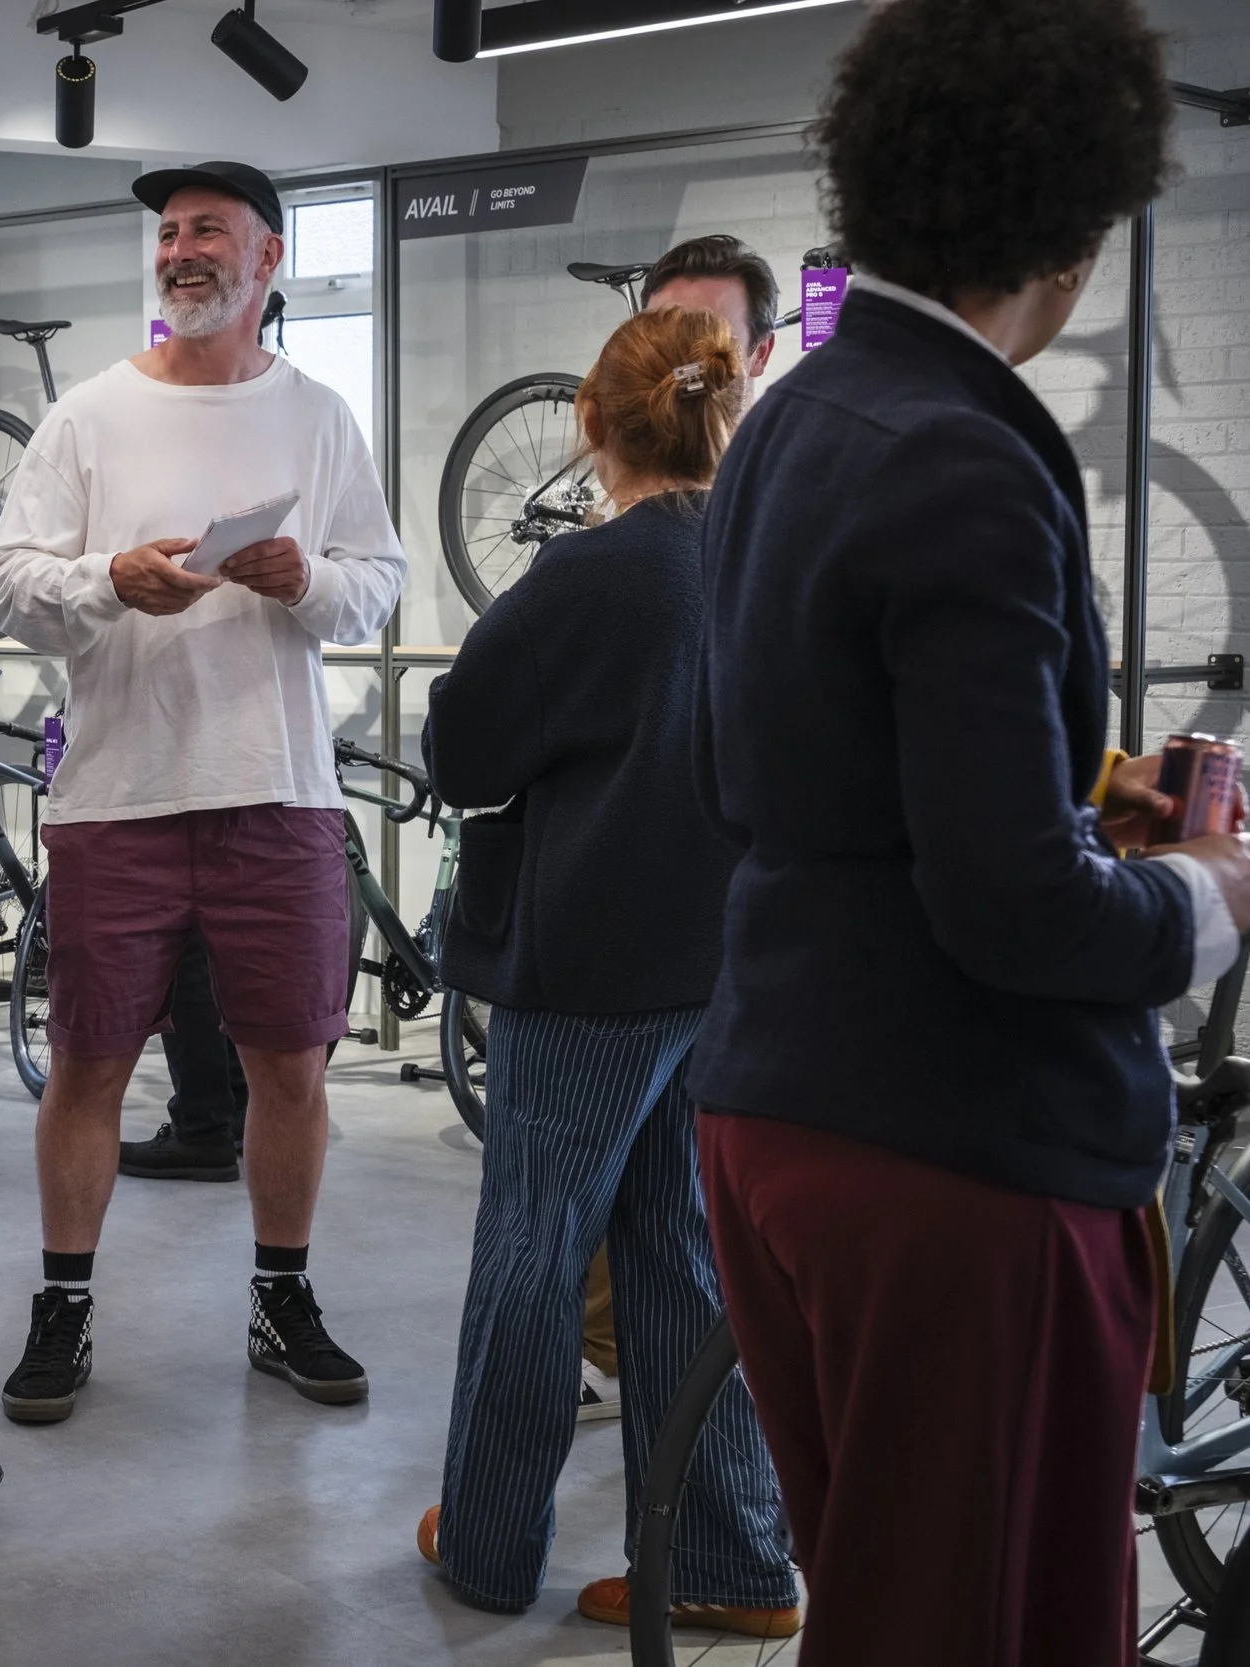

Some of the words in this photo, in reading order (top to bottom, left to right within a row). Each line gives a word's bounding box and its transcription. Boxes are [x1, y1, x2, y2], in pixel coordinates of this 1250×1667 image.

[404, 194, 458, 220] AVAIL
[490, 189, 502, 199] GO
[503, 185, 535, 198] BEYOND
[490, 200, 515, 211] LIMITS
